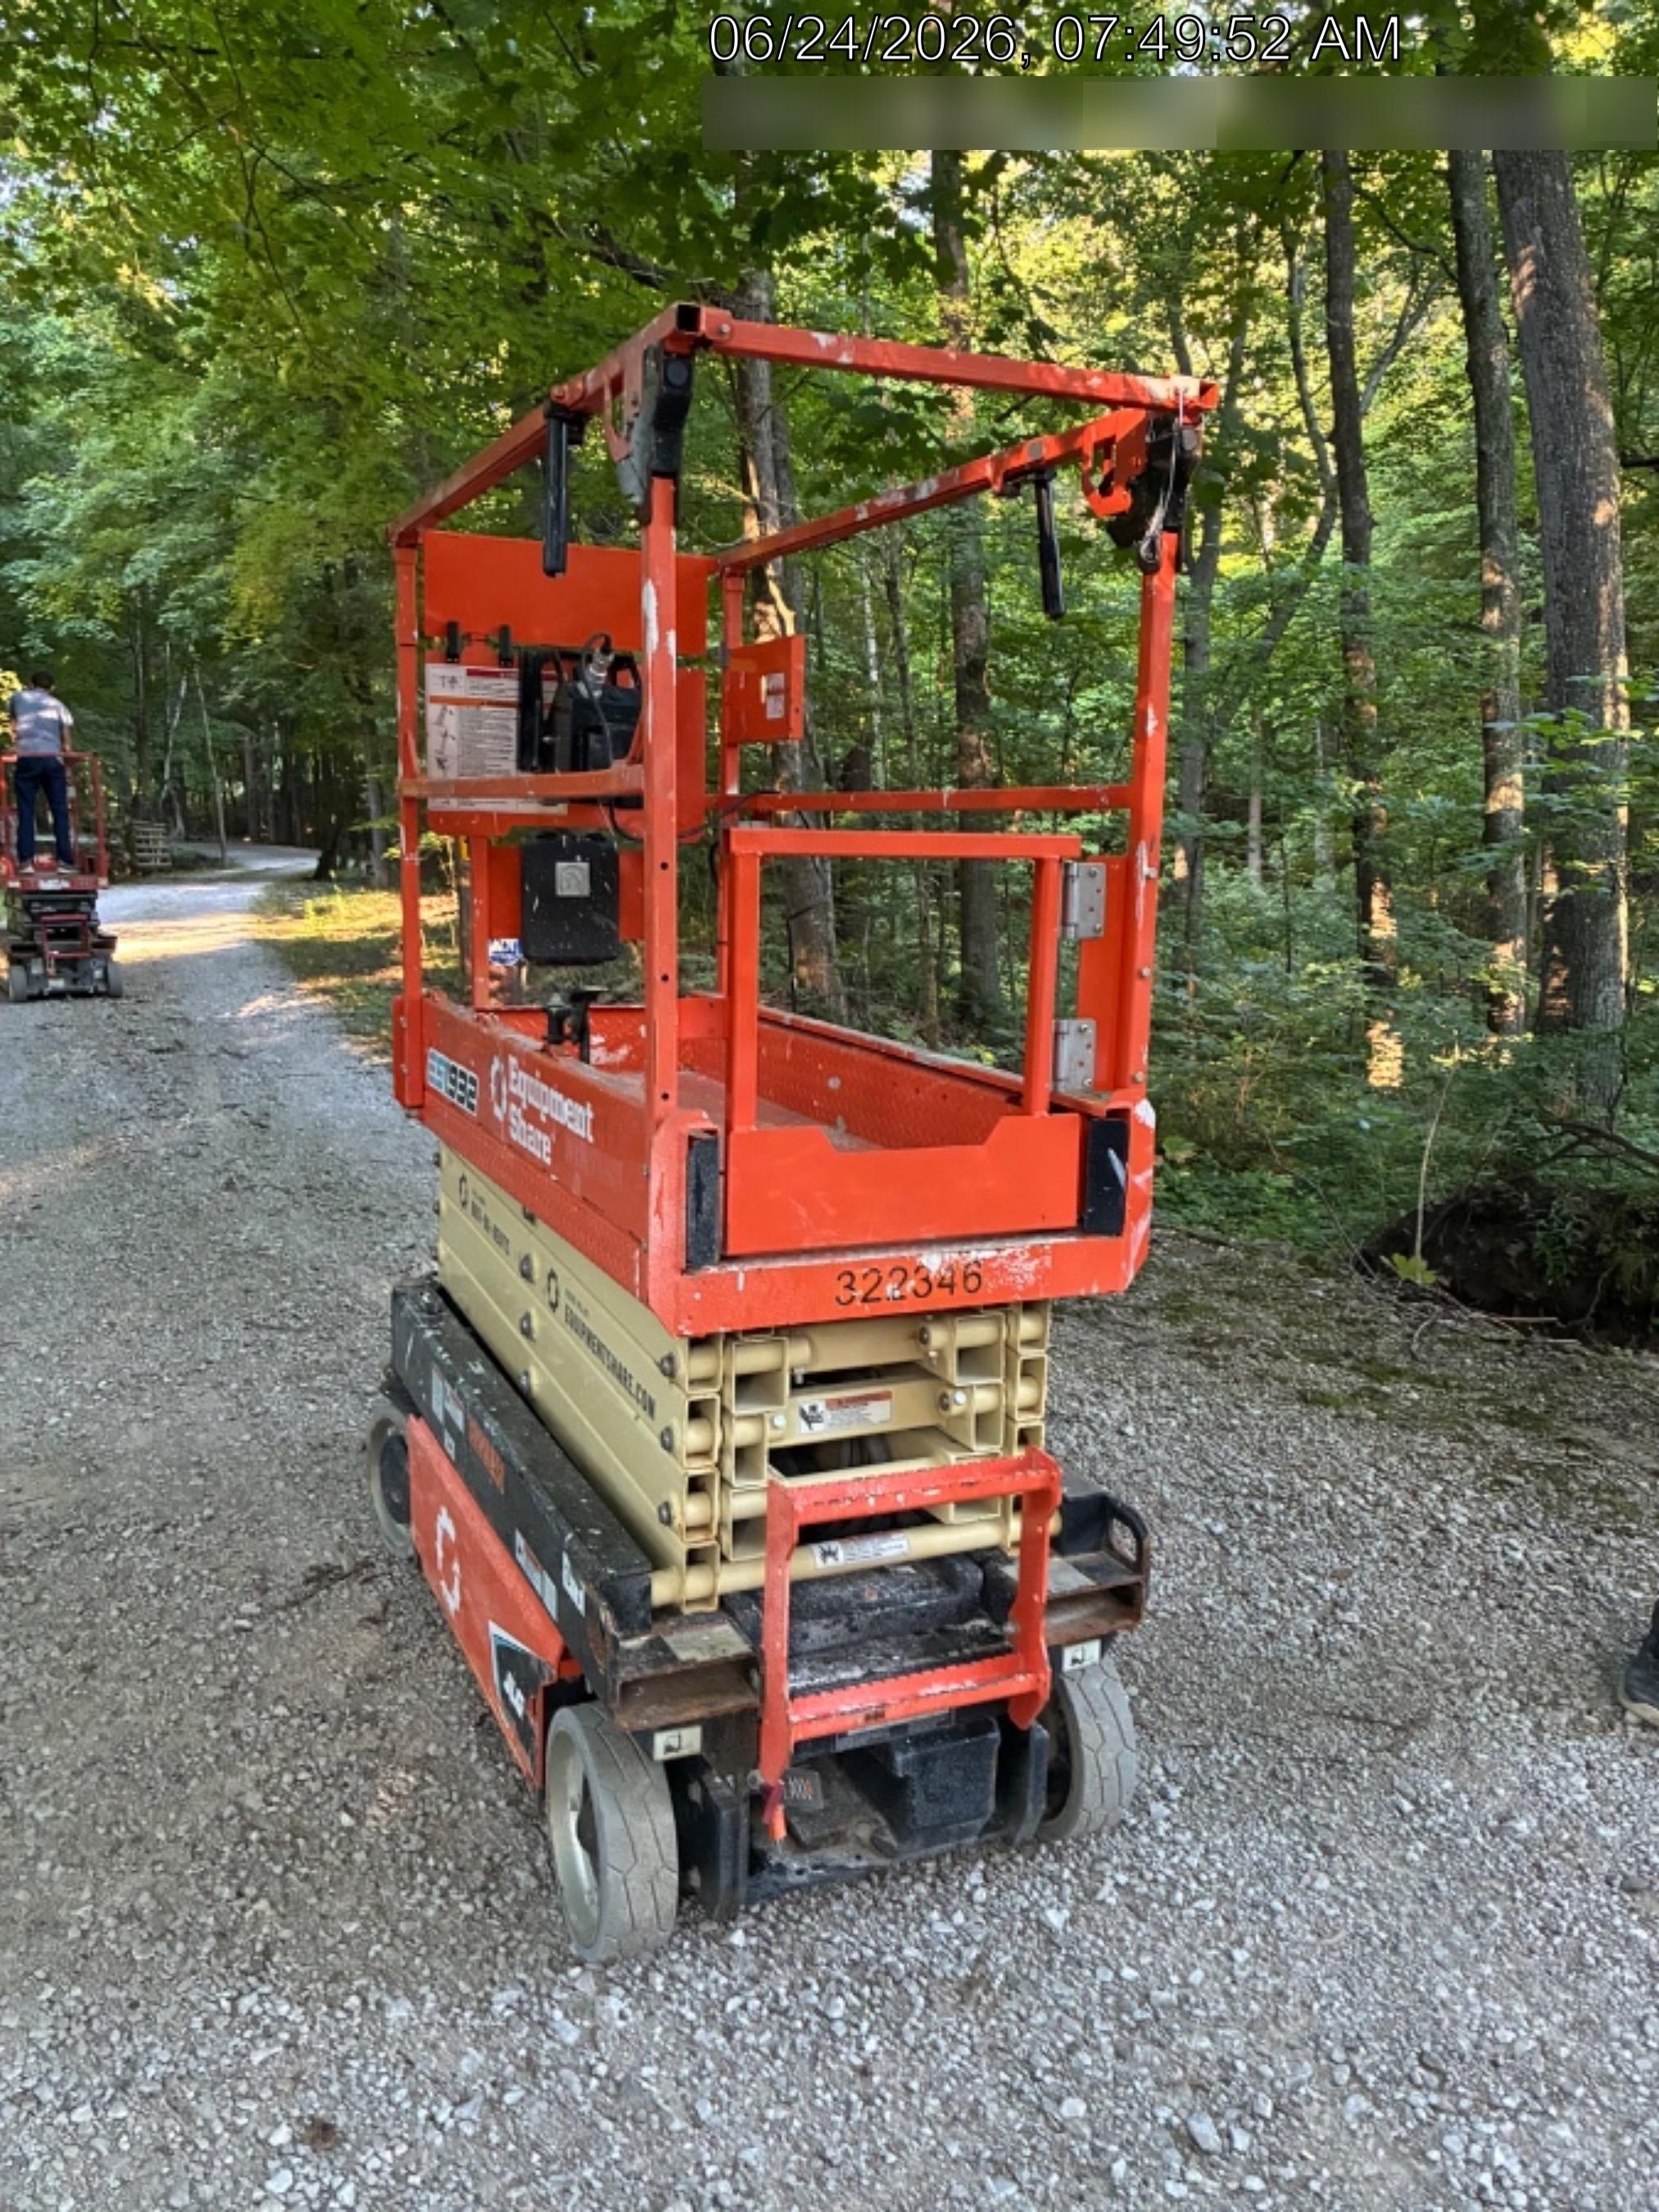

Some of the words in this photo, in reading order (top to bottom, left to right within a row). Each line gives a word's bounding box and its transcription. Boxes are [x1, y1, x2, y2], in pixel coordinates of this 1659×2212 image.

[508, 1054, 593, 1143] Equipment
[510, 1104, 551, 1166] Share
[835, 1261, 982, 1306] 322346
